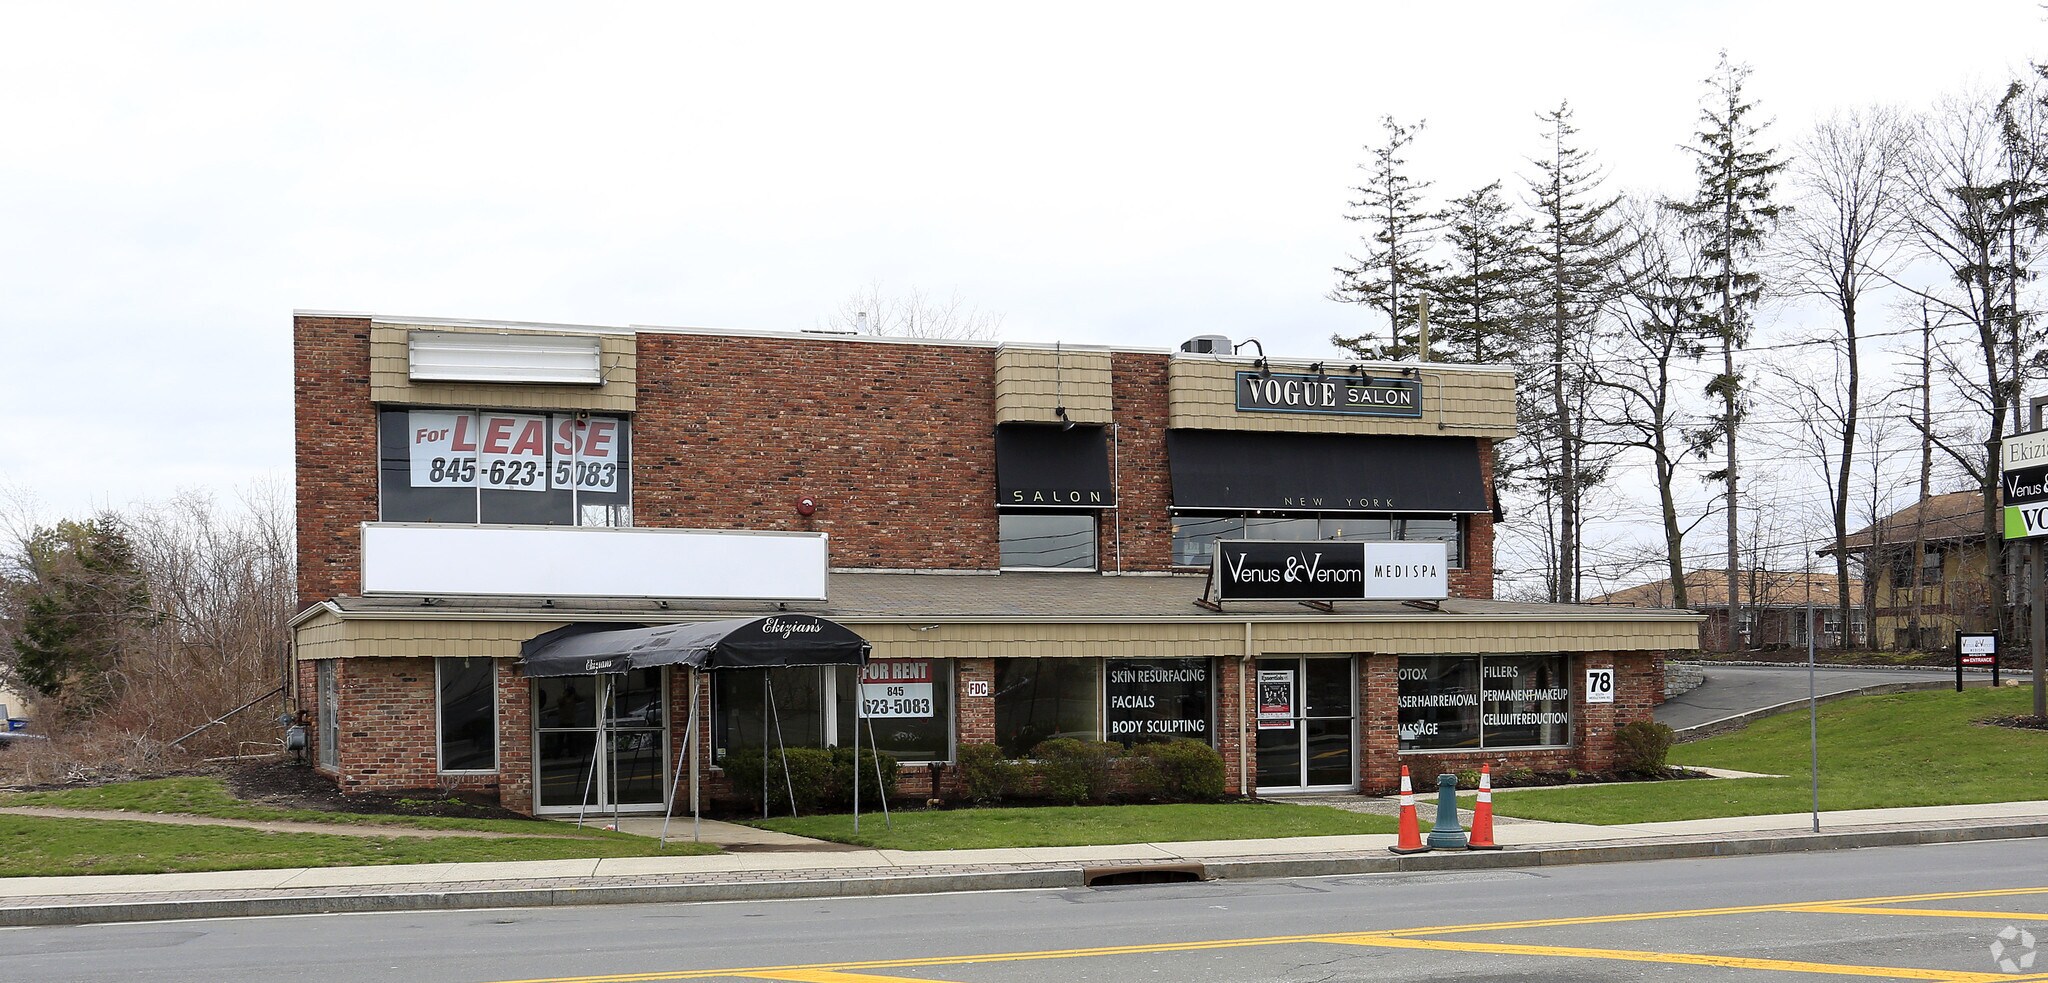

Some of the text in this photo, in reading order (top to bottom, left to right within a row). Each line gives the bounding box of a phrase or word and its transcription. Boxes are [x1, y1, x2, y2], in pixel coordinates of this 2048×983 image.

[1247, 378, 1411, 407] VOGUE SALON
[415, 415, 615, 457] For LEASE
[2006, 475, 2041, 498] Venus
[1013, 490, 1101, 503] SALON
[1284, 497, 1393, 507] NEW YORK
[1224, 550, 1361, 583] Venus & Venom
[1374, 564, 1437, 578] MEDISPA
[762, 618, 824, 639] Ekizian's
[862, 662, 928, 680] FOR RENT
[1111, 669, 1205, 683] SKIN RESURFACING
[1484, 666, 1519, 678] FILLERS
[969, 683, 987, 695] FDC
[1589, 672, 1611, 692] 78
[887, 687, 904, 697] 845
[1534, 688, 1568, 701] MAKEUP
[862, 698, 930, 715] 623-5083
[1111, 695, 1155, 708] FACIALS
[1418, 695, 1439, 707] HAIR
[1439, 694, 1479, 707] REMOVAL
[1483, 712, 1568, 726] CELLULITE REDUCTION
[1112, 719, 1206, 734] BODY SCULPTING
